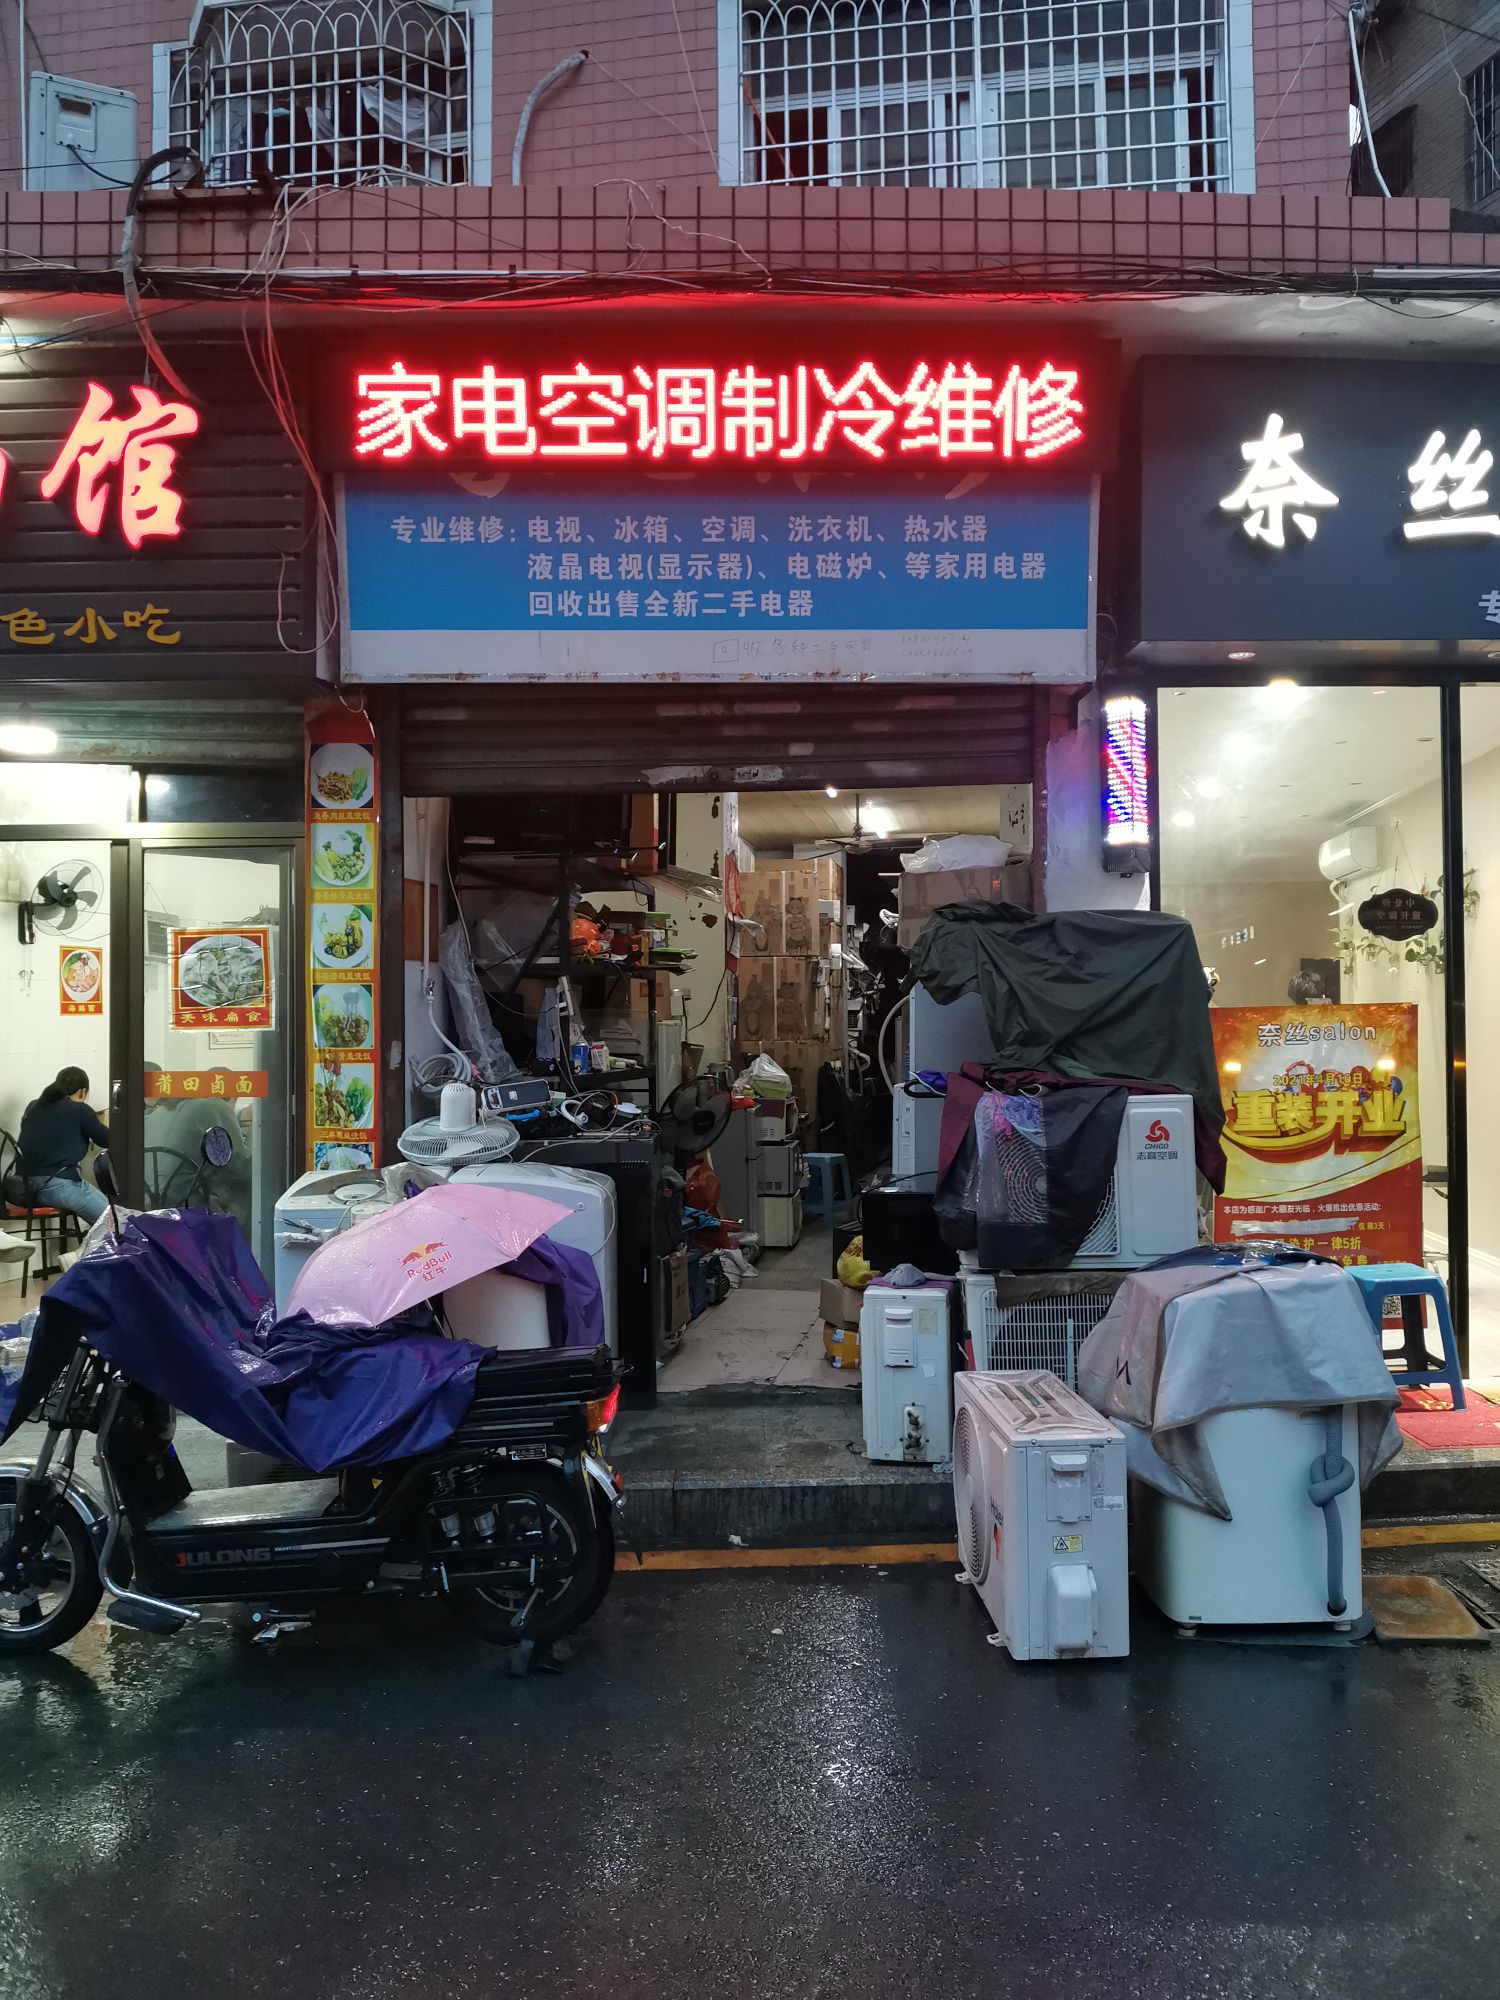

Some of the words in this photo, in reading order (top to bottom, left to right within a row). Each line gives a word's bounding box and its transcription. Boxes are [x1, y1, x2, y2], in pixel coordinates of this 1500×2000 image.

[355, 362, 1083, 461] 家电空调制冷维修
[40, 381, 199, 550] 馆
[1219, 412, 1500, 549] 奈丝
[528, 589, 814, 618] 回收出售全新二手电器
[0, 602, 182, 646] 色小吃
[180, 1011, 262, 1024] 美味扁食
[155, 1073, 254, 1096] 莆田卤面
[1232, 1089, 1407, 1140] 重装开业
[1144, 1143, 1169, 1151] CHIGO
[421, 1266, 448, 1282] 红牛
[176, 1547, 272, 1569] JULONG
